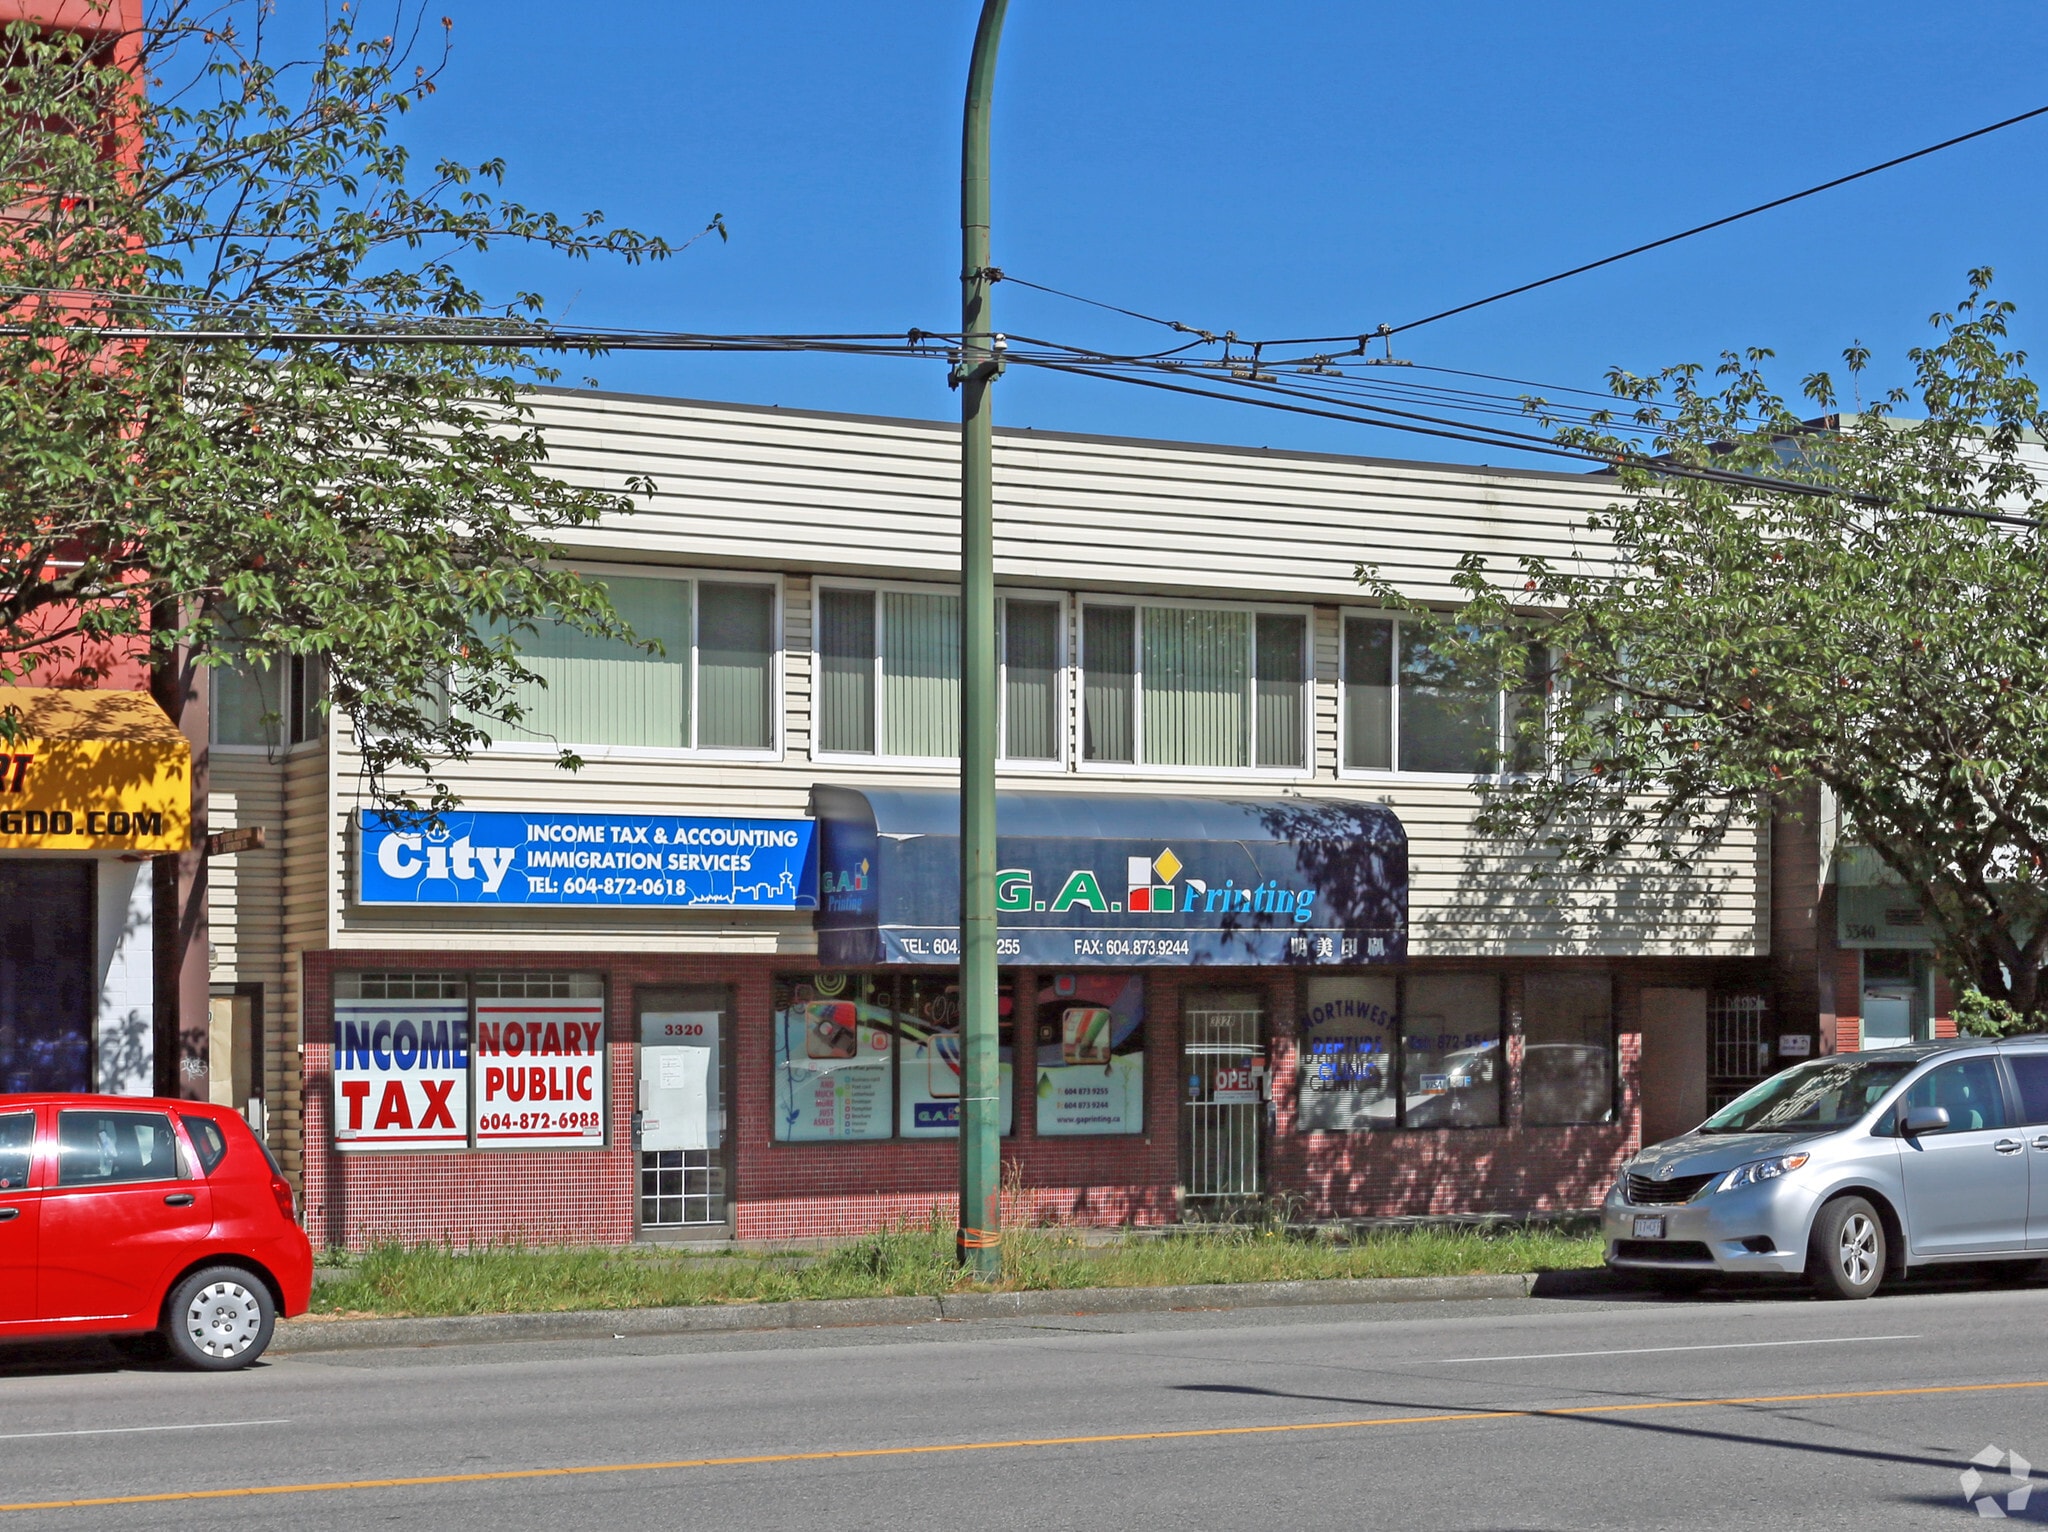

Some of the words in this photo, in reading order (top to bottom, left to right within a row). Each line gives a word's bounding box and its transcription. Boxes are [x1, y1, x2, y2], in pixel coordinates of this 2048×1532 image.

[527, 824, 605, 843] INCOME
[610, 826, 651, 844] TAX
[654, 827, 667, 845] &
[671, 828, 798, 848] ACCOUNTING
[378, 826, 515, 893] City
[527, 852, 662, 870] IMMIGRATION
[668, 854, 751, 872] SERVICES
[527, 877, 558, 894] TEL:
[563, 877, 686, 896] 604-872-0618
[823, 870, 855, 893] G.A.
[996, 869, 1122, 914] G.A.
[829, 894, 862, 915] Printing
[1181, 878, 1316, 923] Printing
[900, 938, 929, 954] TEL:
[1074, 939, 1103, 955] FAX:
[1106, 940, 1189, 956] 604.873.9244
[1301, 1000, 1398, 1033] NORTHWEST
[478, 1021, 601, 1057] NOTARY
[665, 1025, 703, 1036] 3320
[335, 1020, 468, 1071] INCOME
[1312, 1035, 1382, 1054] DENTURE
[1215, 1071, 1258, 1089] OPEN
[1318, 1062, 1379, 1081] CLINIC
[486, 1066, 592, 1101] PUBLIC
[1064, 1087, 1077, 1095] 604
[1078, 1087, 1091, 1095] 873
[1092, 1087, 1109, 1095] 9255
[1425, 1081, 1443, 1089] VISA
[342, 1080, 456, 1130] TAX
[480, 1112, 599, 1130] 604-872-6988
[1057, 1115, 1121, 1124] www.gaprinting.ca
